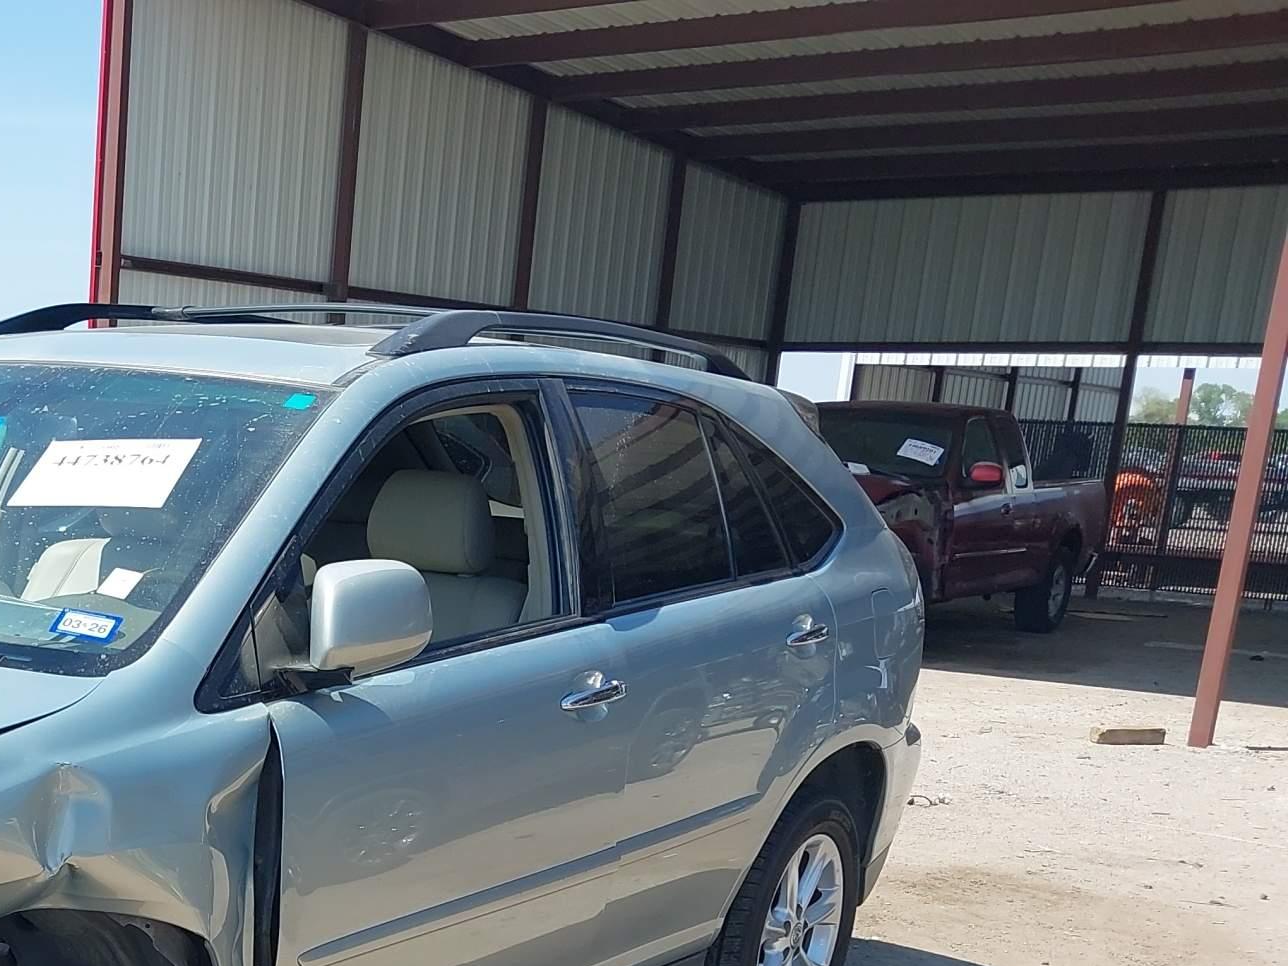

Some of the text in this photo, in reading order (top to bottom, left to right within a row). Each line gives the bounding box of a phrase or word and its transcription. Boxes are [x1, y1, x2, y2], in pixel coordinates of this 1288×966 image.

[52, 454, 171, 467] 44738764
[62, 618, 108, 634] 03 26
